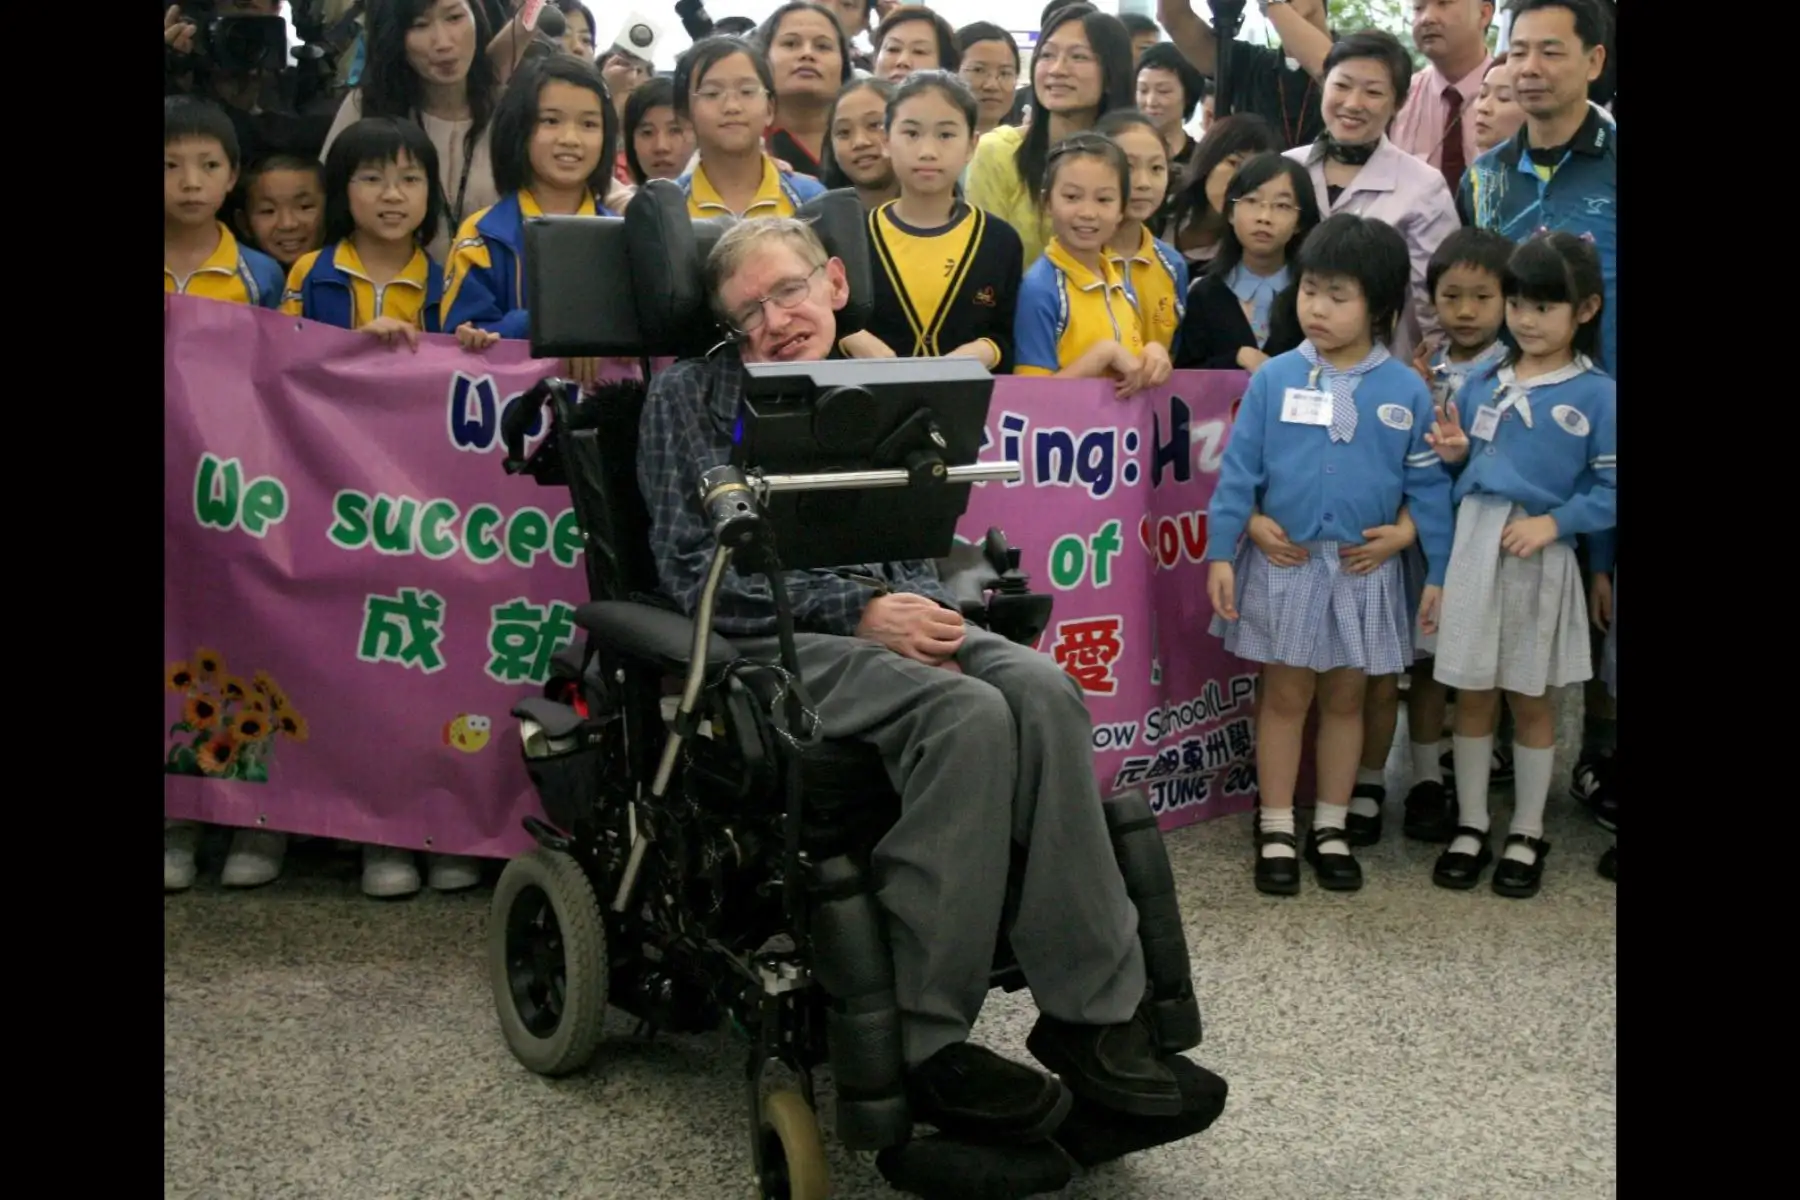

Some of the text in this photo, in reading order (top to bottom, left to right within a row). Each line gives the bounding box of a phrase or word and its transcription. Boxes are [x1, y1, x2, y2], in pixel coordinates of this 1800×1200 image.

[971, 411, 1140, 499] ing:
[194, 452, 288, 537] We
[1048, 518, 1123, 590] of
[1149, 773, 1217, 816] JUNE
